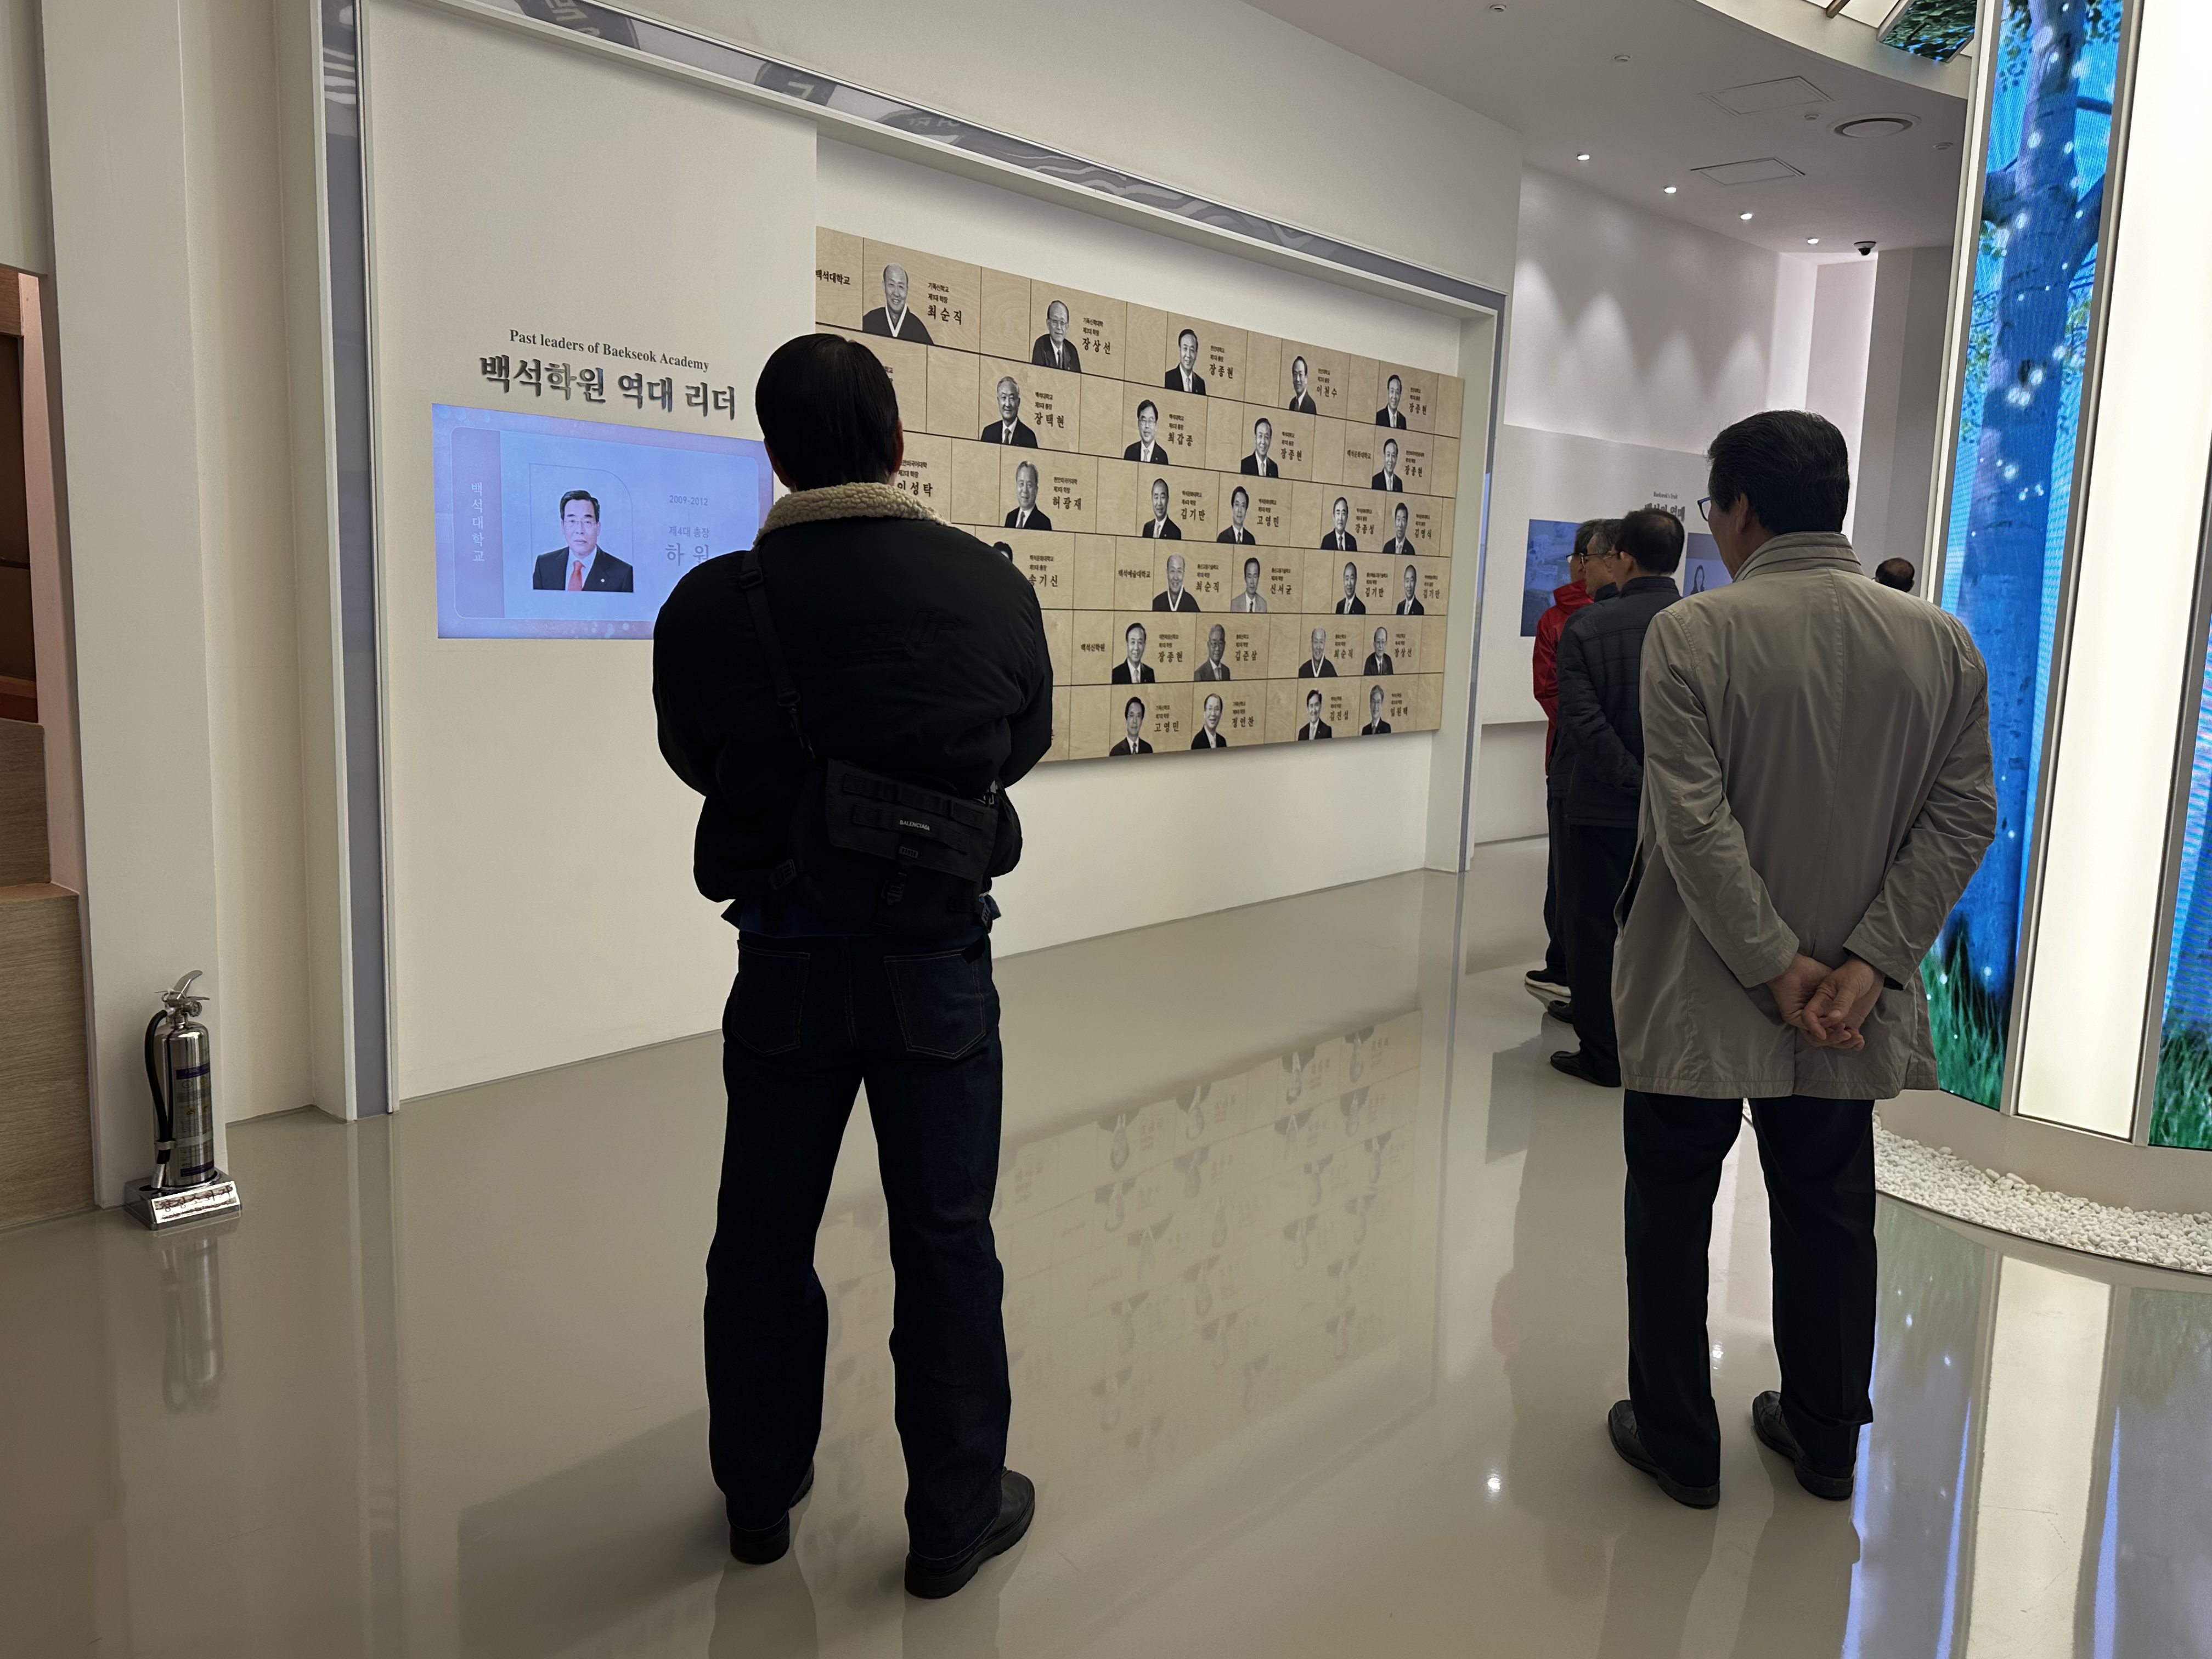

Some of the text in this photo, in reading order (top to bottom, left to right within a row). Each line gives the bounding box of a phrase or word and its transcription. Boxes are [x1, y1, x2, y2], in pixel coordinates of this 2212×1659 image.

[927, 304, 962, 325] 최순직
[510, 329, 709, 373] Past leaders of Baekseok Academy
[479, 354, 736, 421] 백석학원 역대 리더
[669, 495, 708, 506] 2009-2012
[471, 481, 486, 562] 백석대학교
[669, 526, 710, 538] 제4대 총장
